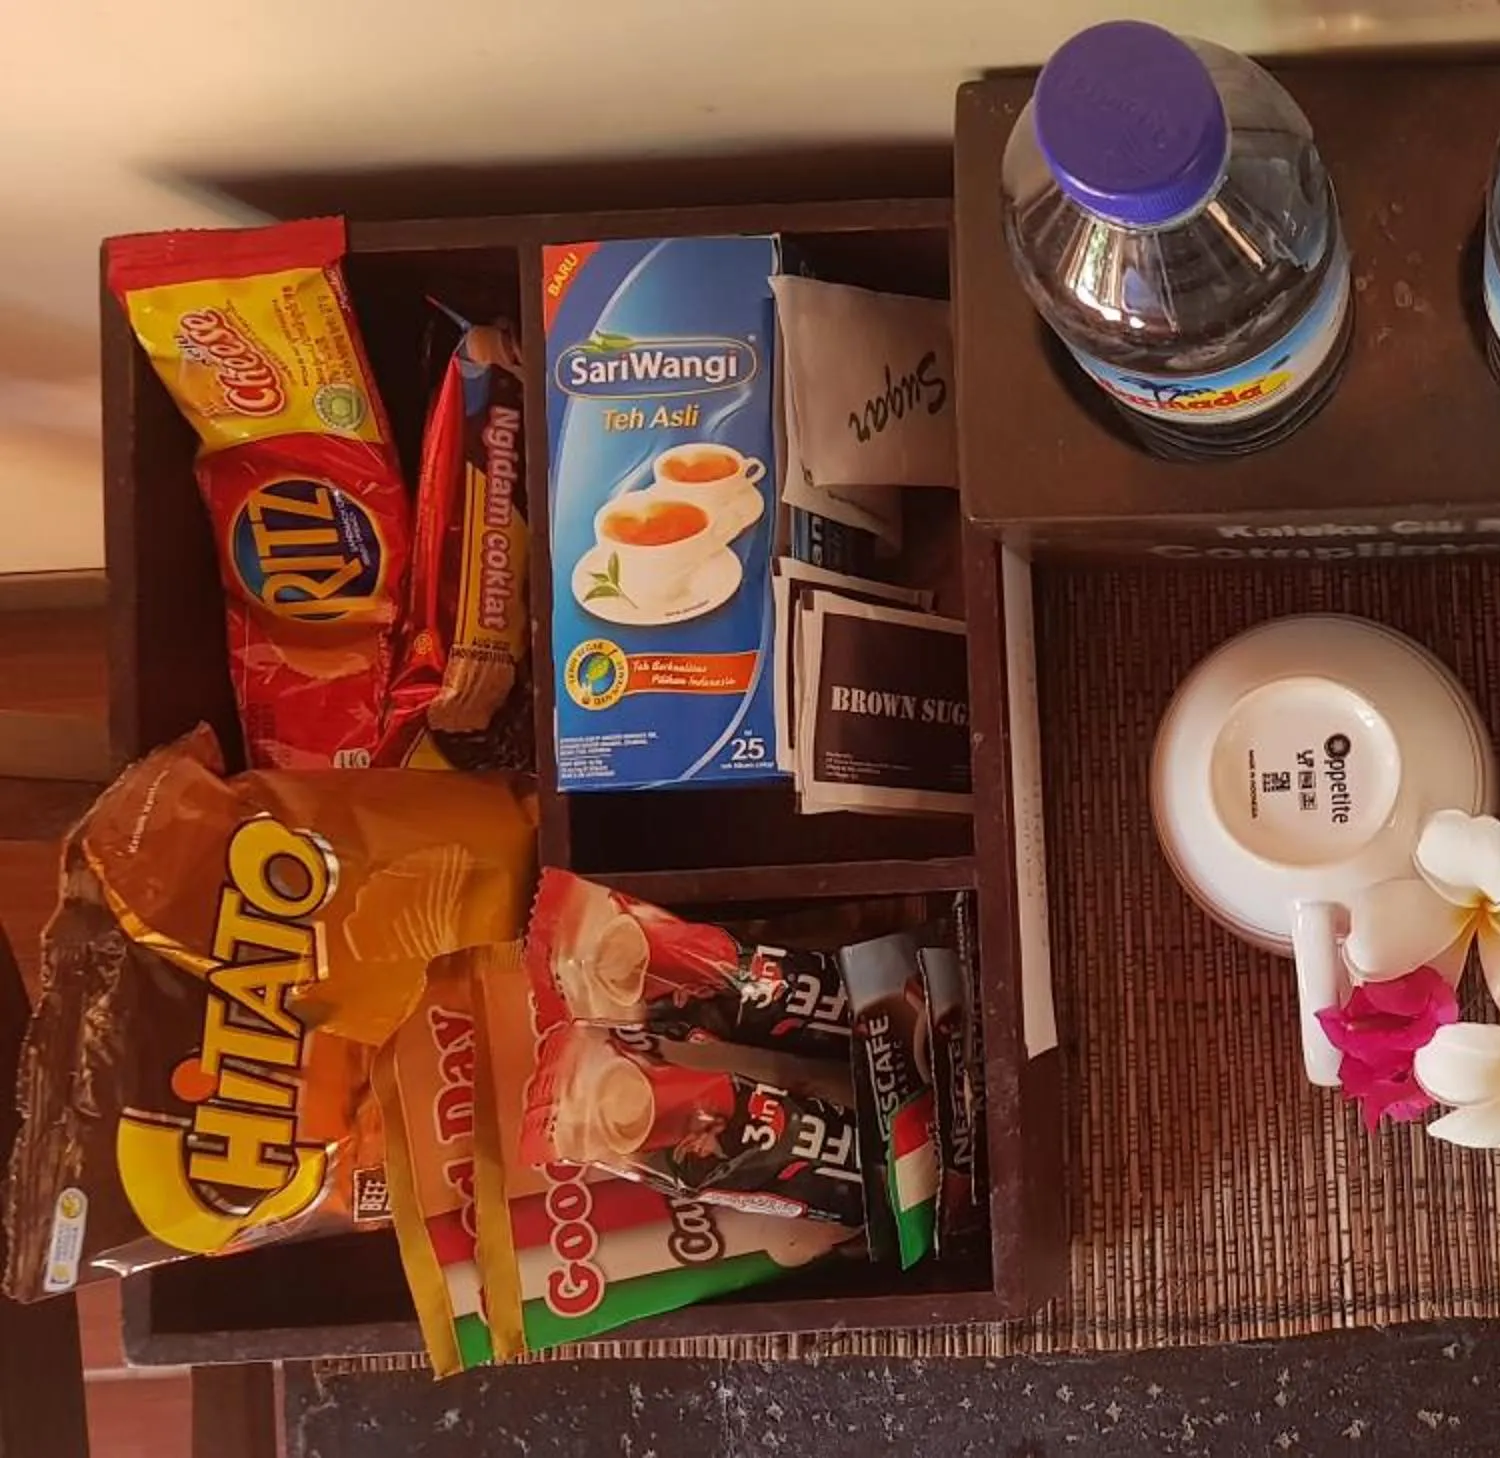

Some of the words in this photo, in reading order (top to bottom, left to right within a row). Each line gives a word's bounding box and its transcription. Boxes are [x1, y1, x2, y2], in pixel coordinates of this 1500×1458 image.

[547, 252, 578, 297] BARU
[181, 309, 284, 416] Cheese
[570, 351, 738, 386] SariWangi
[602, 406, 644, 431] Teh
[650, 402, 700, 430] Asli
[848, 350, 947, 443] Sugar
[483, 405, 520, 527] Ngidam
[247, 486, 378, 614] RITZ
[482, 530, 512, 629] coklat
[831, 685, 917, 720] BROWN
[920, 697, 969, 727] SUG
[731, 737, 766, 760] 25
[740, 1083, 789, 1152] 3in1
[359, 1179, 388, 1211] BEEF
